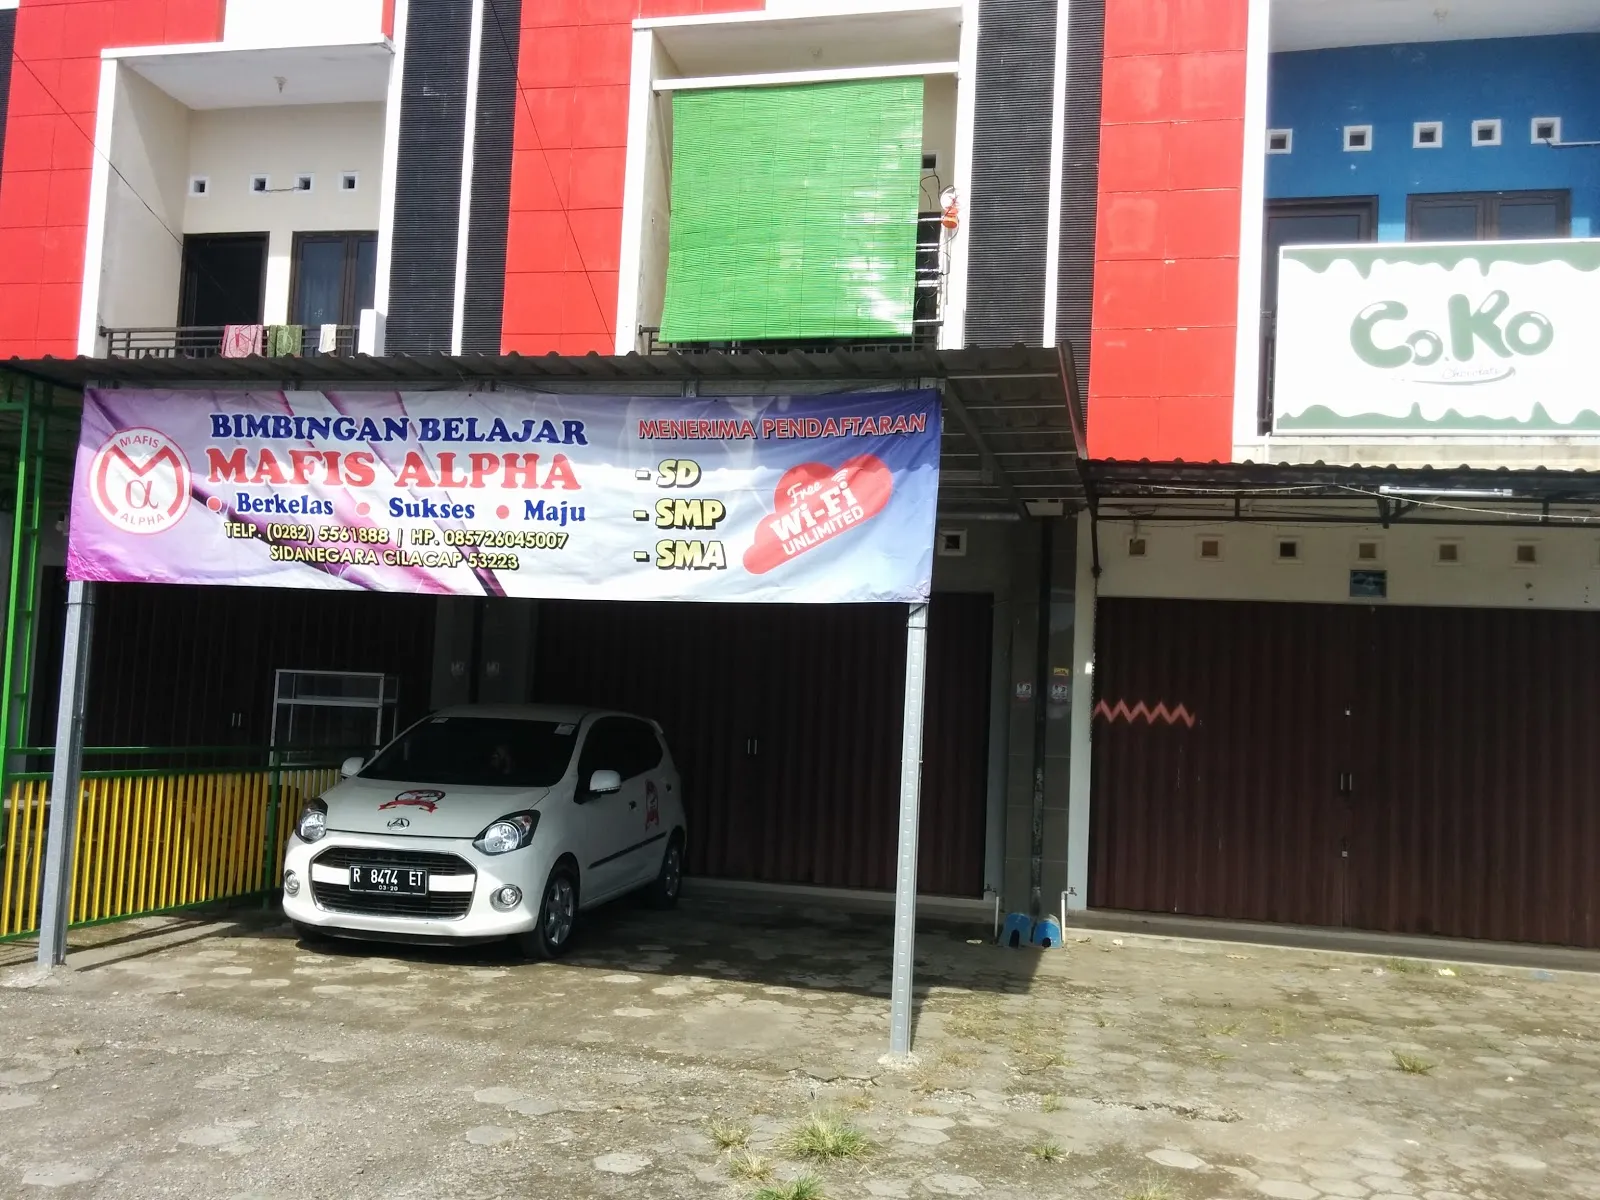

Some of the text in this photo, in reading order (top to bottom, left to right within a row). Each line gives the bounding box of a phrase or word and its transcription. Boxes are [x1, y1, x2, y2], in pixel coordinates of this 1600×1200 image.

[209, 414, 589, 446] BIMBINGAN BELAJAR
[638, 412, 927, 440] MENERIMA PENDAFTARAN
[119, 435, 160, 448] MAFIS
[206, 448, 582, 490] MAFIS ALPHA
[656, 459, 702, 488] SD
[236, 492, 586, 527] Berkelas Sukses Maju
[787, 482, 823, 508] Free
[120, 512, 165, 526] ALPHA
[655, 498, 726, 529] SMP
[770, 480, 857, 542] Wi-Fi
[224, 522, 262, 539] TELP.
[266, 523, 315, 544] (0282)
[318, 526, 390, 544] 5561888
[410, 529, 440, 546] HP.
[443, 529, 569, 549] 085726045007
[782, 505, 865, 556] UNLIMITED
[269, 544, 519, 571] SIDANEGARA CILACAP 53223
[655, 539, 727, 570] SMA
[353, 868, 423, 886] R 8474 ET
